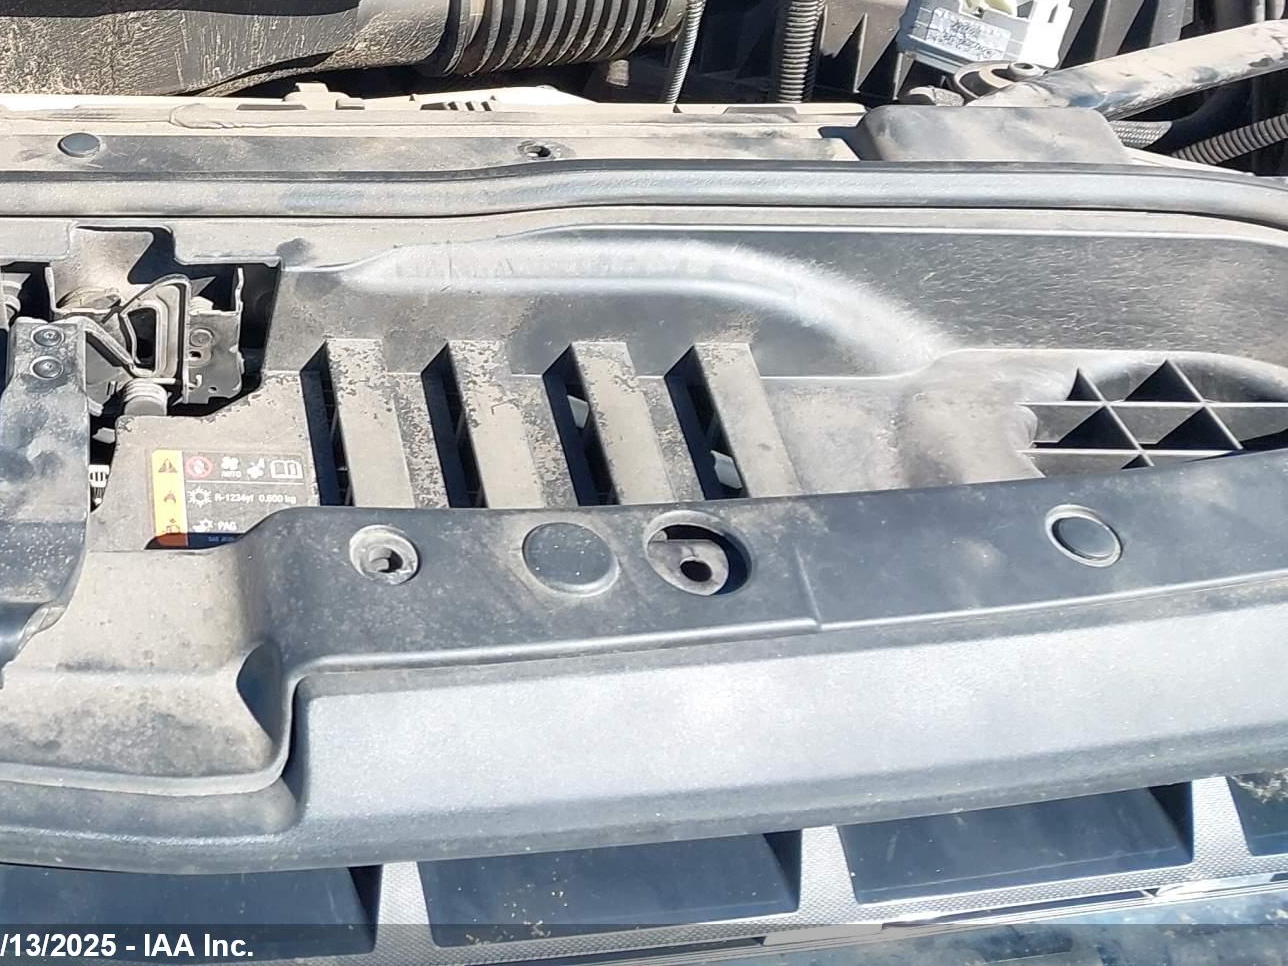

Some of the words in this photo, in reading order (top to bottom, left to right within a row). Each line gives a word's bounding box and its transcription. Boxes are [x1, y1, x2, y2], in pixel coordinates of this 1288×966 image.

[221, 470, 242, 478] AUTO
[214, 493, 254, 504] R-1234yf
[284, 494, 297, 505] kg
[218, 521, 237, 531] PAG
